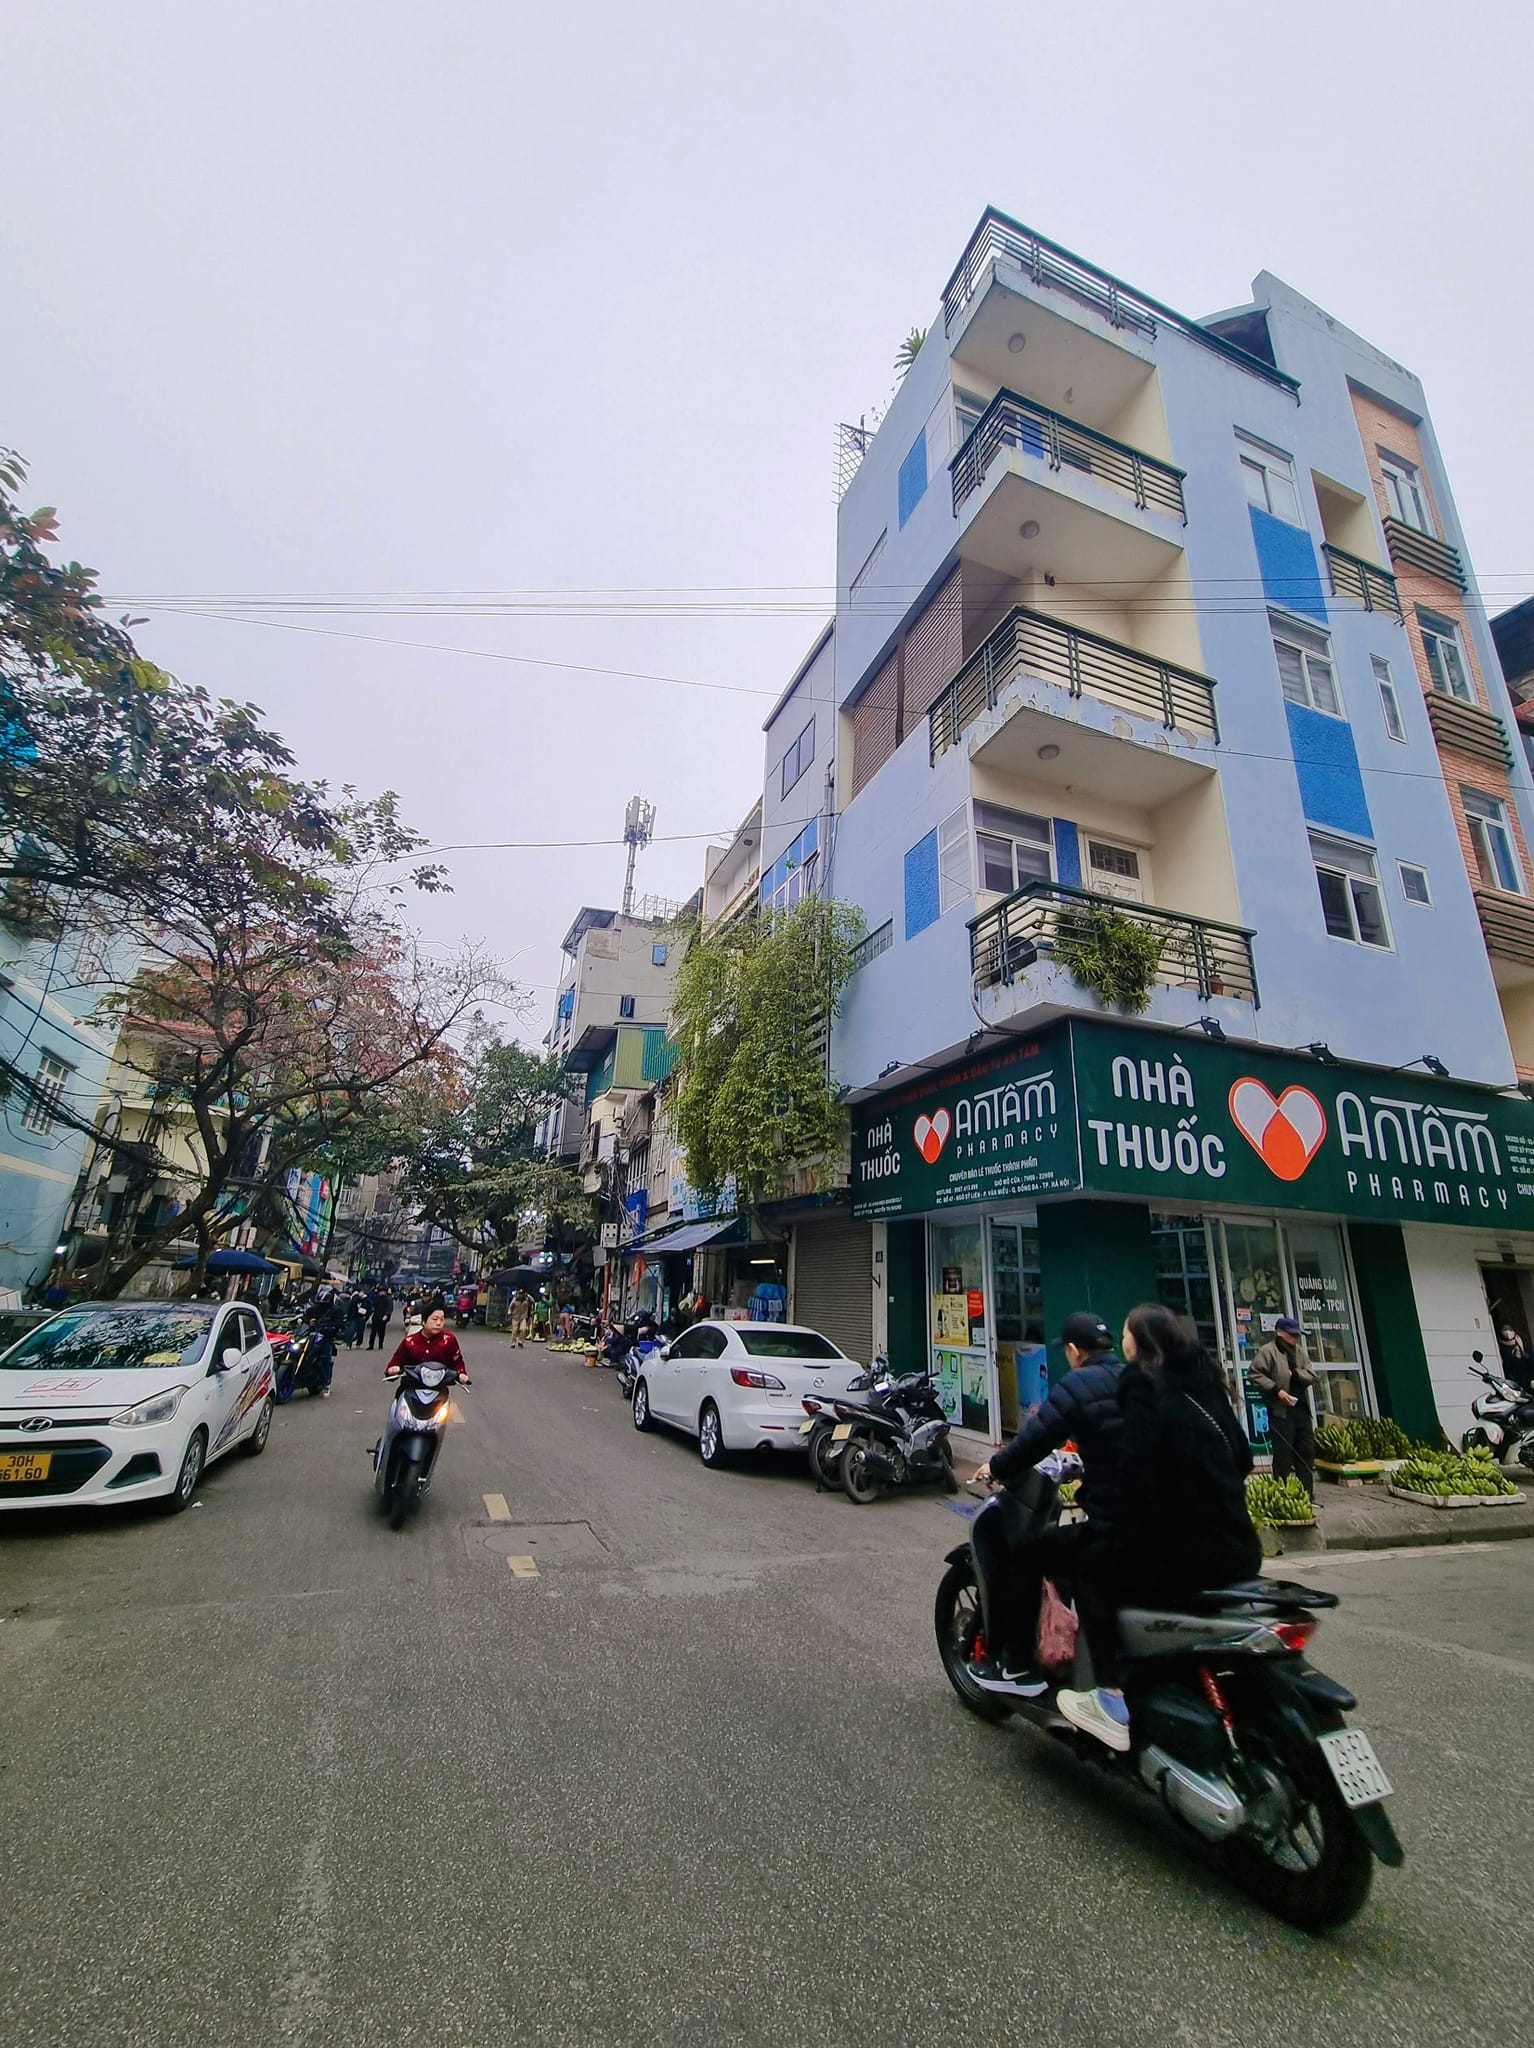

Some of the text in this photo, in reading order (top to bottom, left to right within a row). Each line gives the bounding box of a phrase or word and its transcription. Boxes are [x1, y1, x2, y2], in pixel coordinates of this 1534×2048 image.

[1112, 1053, 1194, 1108] NHÀ
[867, 1117, 892, 1149] NHÀ
[956, 1123, 1058, 1159] PHARMACY
[1088, 1115, 1226, 1177] THUỐC
[860, 1145, 901, 1182] THUỐC
[985, 1162, 1001, 1176] THUỐC
[1347, 1170, 1507, 1210] PHARMACY
[1299, 1273, 1337, 1291] QUẢNG CÁO
[1299, 1294, 1322, 1311] THUỐC
[1327, 1299, 1345, 1312] TPCN
[7, 1455, 34, 1467] 30H
